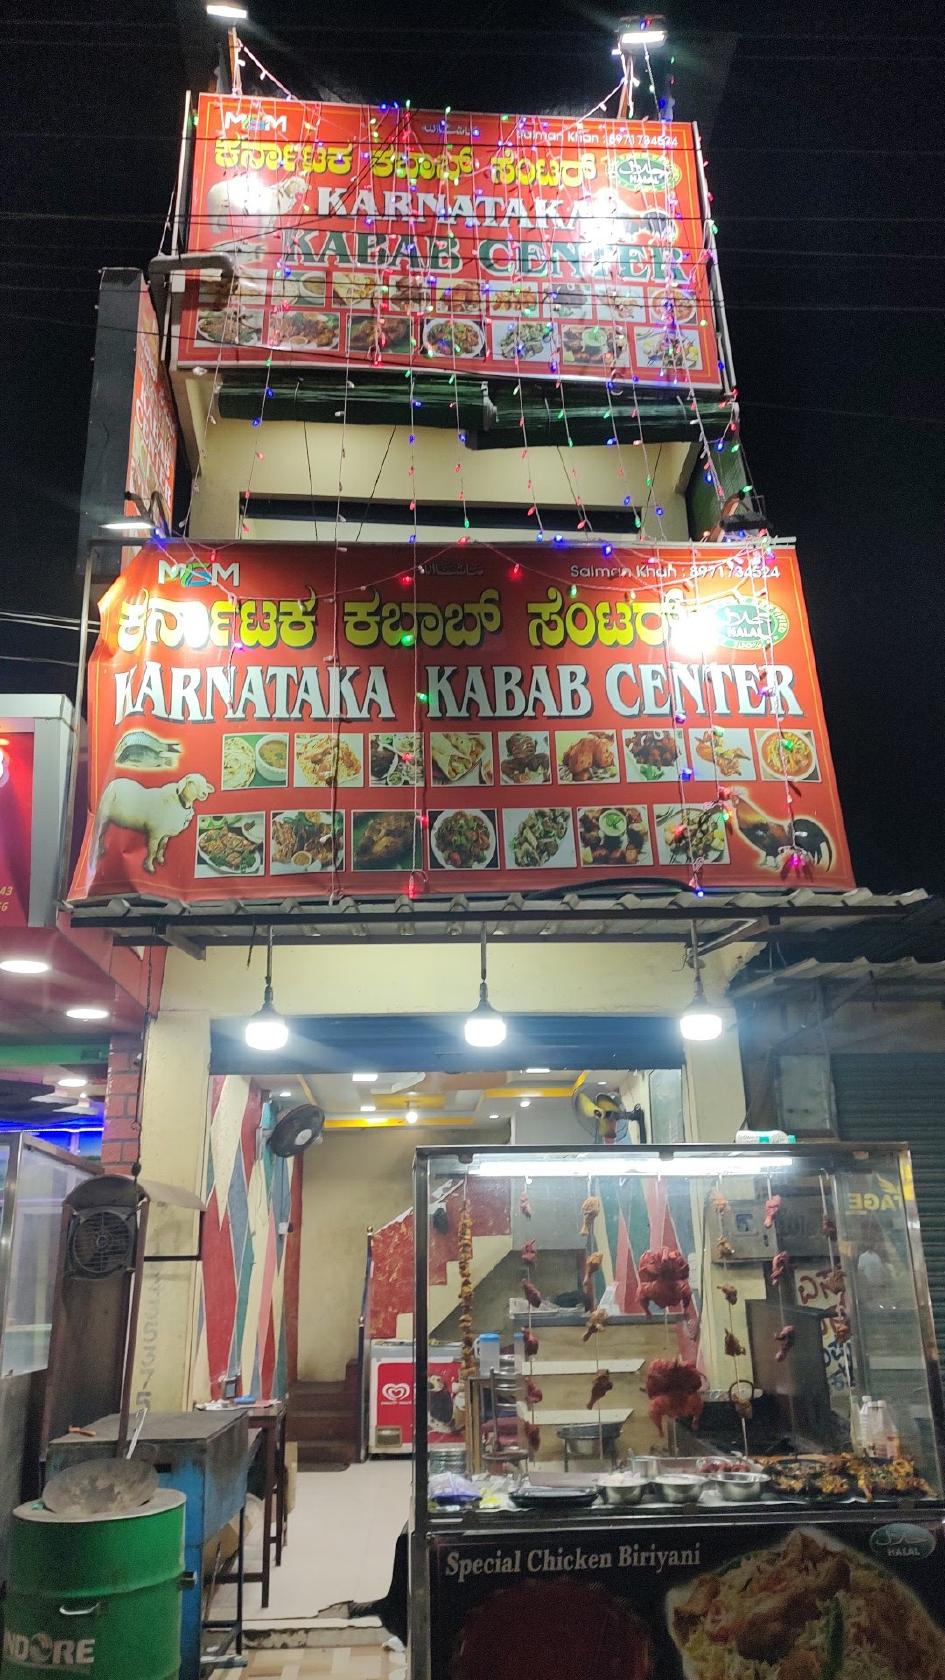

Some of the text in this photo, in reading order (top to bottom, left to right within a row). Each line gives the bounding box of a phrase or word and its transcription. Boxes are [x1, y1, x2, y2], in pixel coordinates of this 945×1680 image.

[281, 229, 463, 273] KABAB
[570, 564, 632, 579] Salman
[636, 564, 677, 579] Khan
[114, 660, 804, 726] KARNATAKA KABAB CENTER
[445, 1542, 702, 1583] Special Chicken Biriyani
